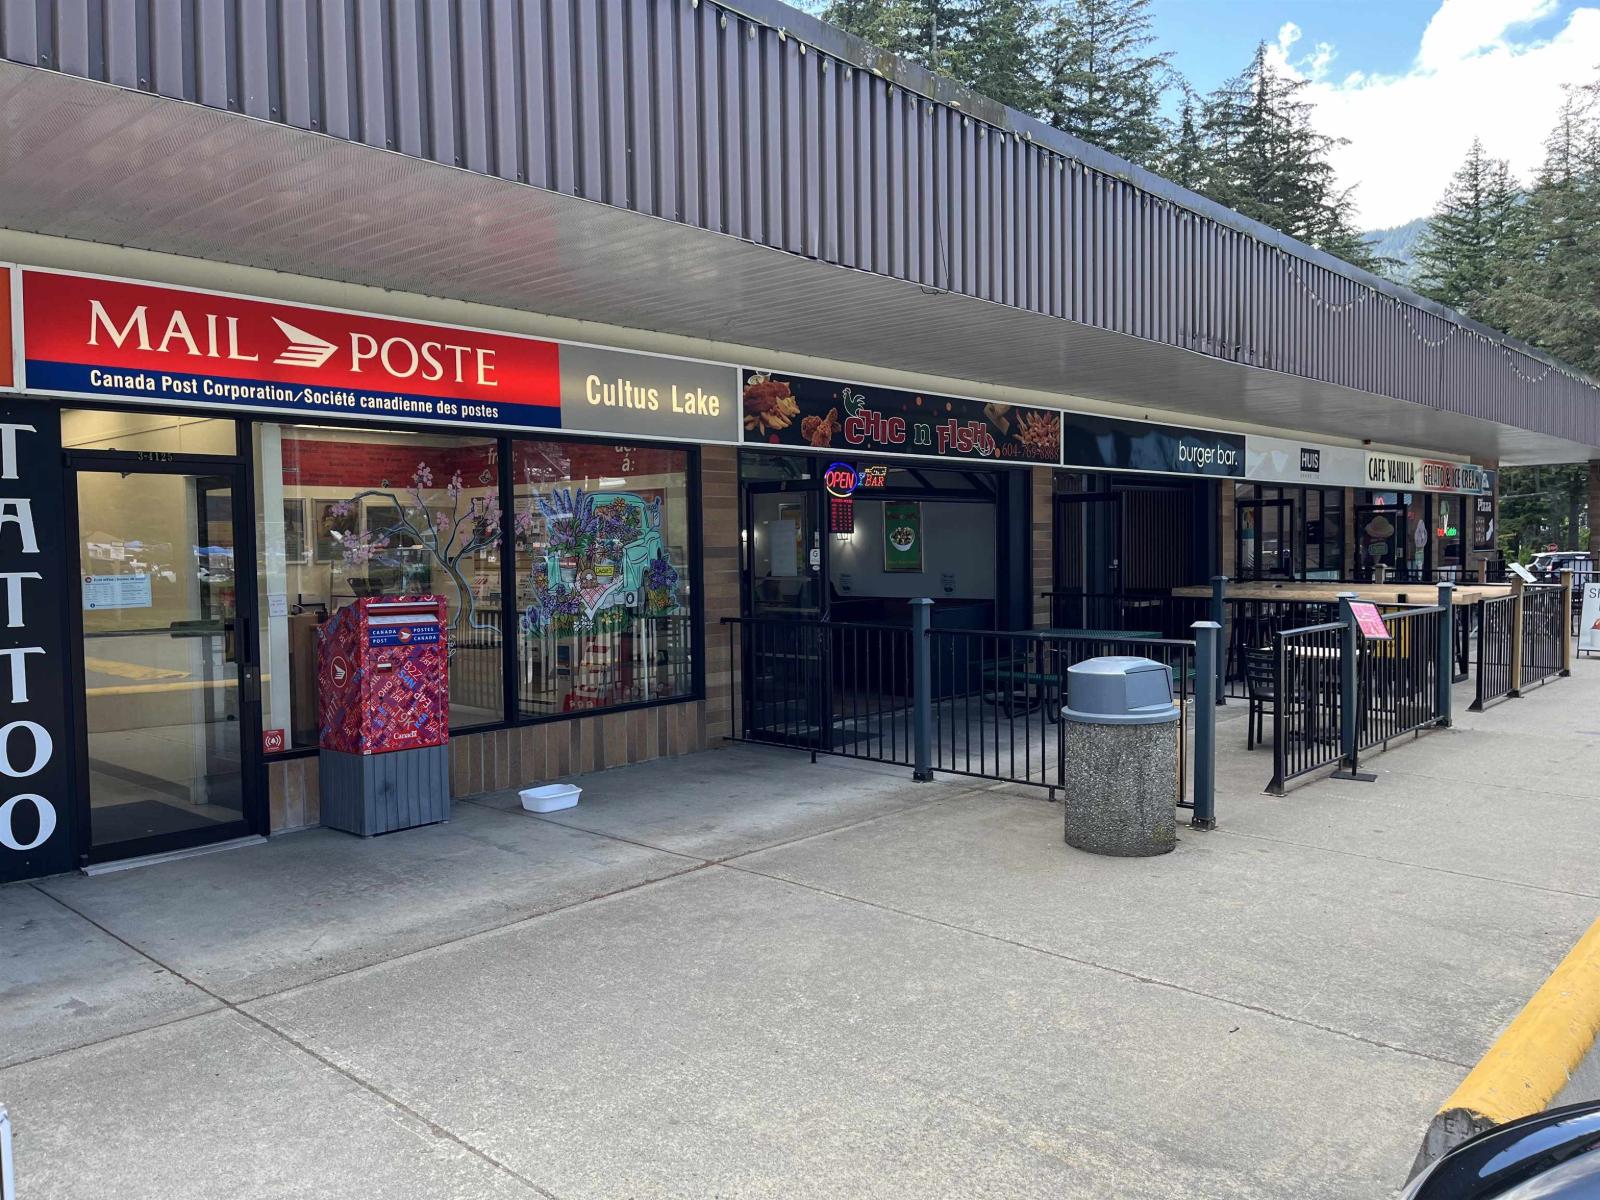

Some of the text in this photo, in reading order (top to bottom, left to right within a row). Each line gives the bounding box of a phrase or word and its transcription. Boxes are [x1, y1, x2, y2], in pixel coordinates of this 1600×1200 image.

[86, 299, 498, 386] MAIL POSTE
[90, 369, 156, 390] Canada
[162, 375, 198, 394] Post
[360, 396, 433, 413] canadienne
[437, 401, 457, 415] des
[461, 404, 499, 418] postes
[586, 374, 720, 417] Cultus Lake
[844, 410, 992, 455] CHIC n FISH
[1178, 440, 1238, 468] burger bar.
[1301, 452, 1319, 469] HUIS
[826, 470, 854, 489] OPEN
[865, 474, 885, 487] BAR
[1368, 458, 1415, 485] CAFE VANILLA
[1423, 464, 1445, 488] GELATO
[1452, 468, 1461, 489] ICE
[0, 423, 57, 850] TATTOO
